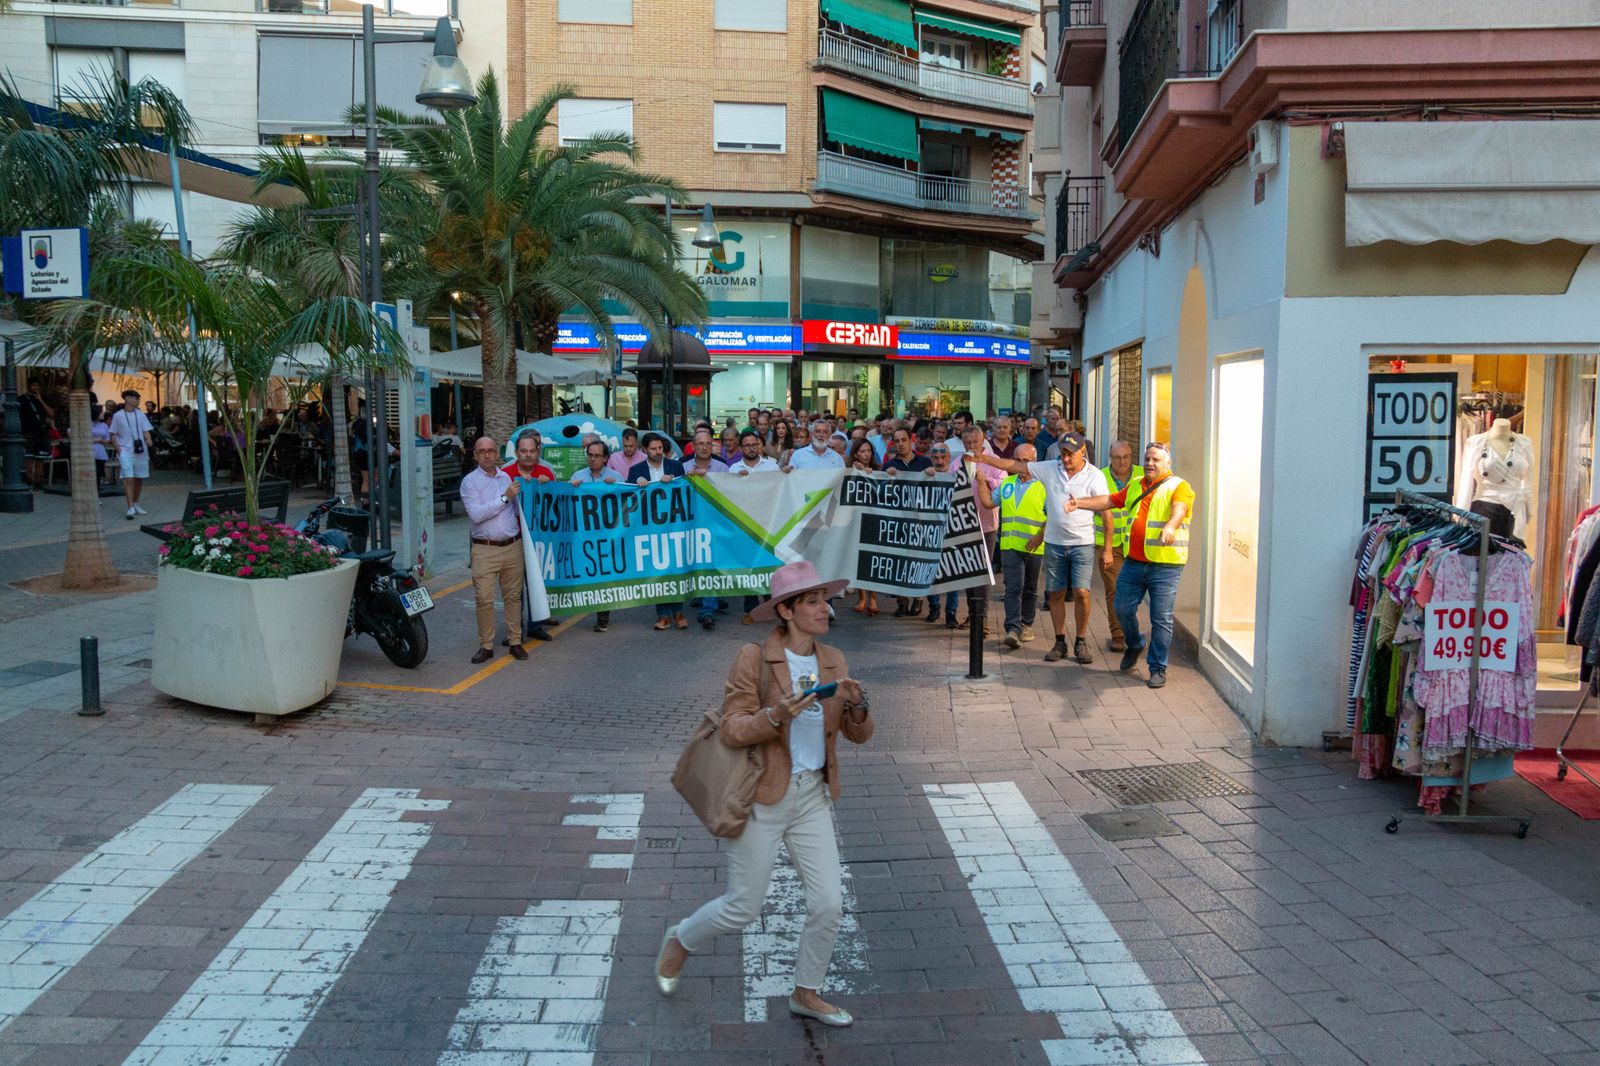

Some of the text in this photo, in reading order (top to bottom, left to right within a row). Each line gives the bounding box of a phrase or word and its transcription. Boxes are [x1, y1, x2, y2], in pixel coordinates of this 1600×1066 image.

[697, 276, 757, 286] GALOMAR
[557, 329, 572, 337] AIRE
[708, 330, 743, 338] ASPIRACIÓN
[962, 321, 988, 333] SEGUROS
[704, 338, 747, 346] CENTRALIZADA
[755, 334, 792, 343] VENTILACIÓN
[902, 342, 930, 350] CALEFACCIÓN
[1377, 391, 1448, 425] TODO
[846, 480, 872, 504] PER
[876, 484, 901, 507] LES
[571, 484, 695, 532] TROPICAL
[879, 519, 908, 545] PELS
[557, 540, 582, 580] PEL
[583, 536, 627, 578] SEU
[634, 527, 713, 572] FUTUR
[870, 555, 894, 580] PER
[895, 559, 908, 583] LA
[559, 592, 573, 608] LES
[572, 581, 678, 607] INFRAESTRUCTURES
[679, 579, 688, 595] DE
[698, 575, 735, 590] COSTA
[410, 599, 427, 612] LRG
[1433, 608, 1509, 630] TODO
[1433, 635, 1507, 663] 49,90€
